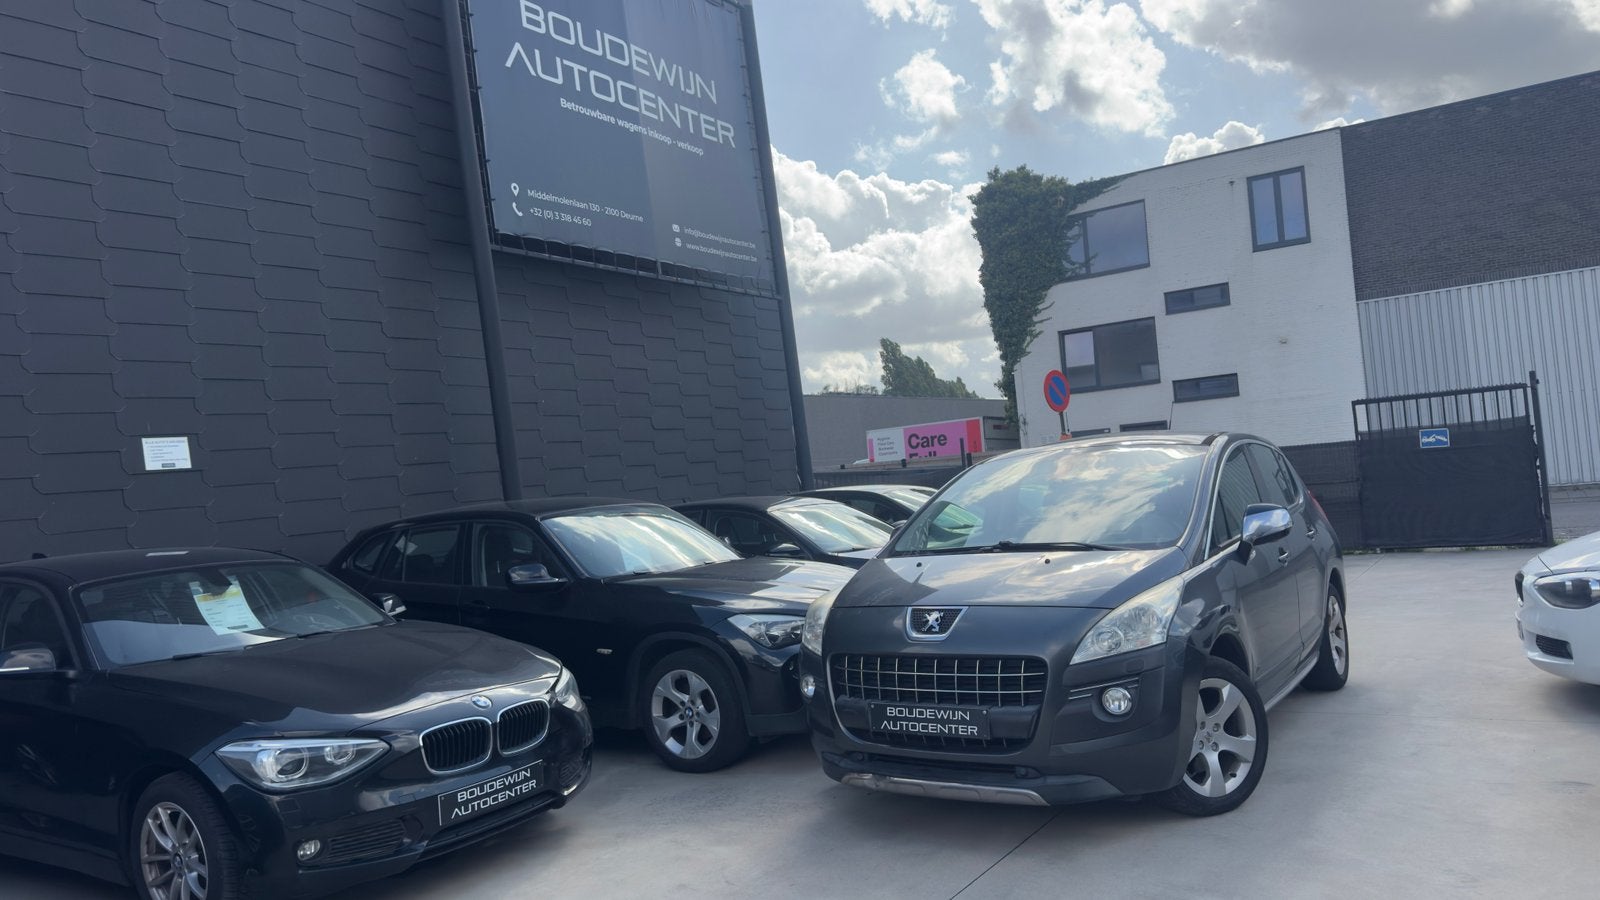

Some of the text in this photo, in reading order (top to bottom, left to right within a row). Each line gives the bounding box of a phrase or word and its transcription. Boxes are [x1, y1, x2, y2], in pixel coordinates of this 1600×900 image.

[520, 0, 717, 105] BOUDEWIJN
[505, 42, 736, 149] AUTOCENTER
[560, 97, 615, 124] Betrouwbare
[617, 117, 647, 134] wagens
[648, 126, 672, 145] inkoop
[676, 139, 704, 156] verkoop
[527, 189, 588, 210] Middelmolenlaan
[589, 203, 600, 212] 130
[605, 206, 620, 217] 2100
[620, 210, 644, 223] Deurne
[530, 207, 592, 227] +32 (0) 3 318 45 60
[908, 433, 947, 449] Care
[880, 721, 978, 736] AUTOCENTER
[886, 707, 970, 721] BOUDEWIJN
[451, 780, 537, 819] AUTOCENTER
[457, 769, 531, 802] BOUDEWIJN
